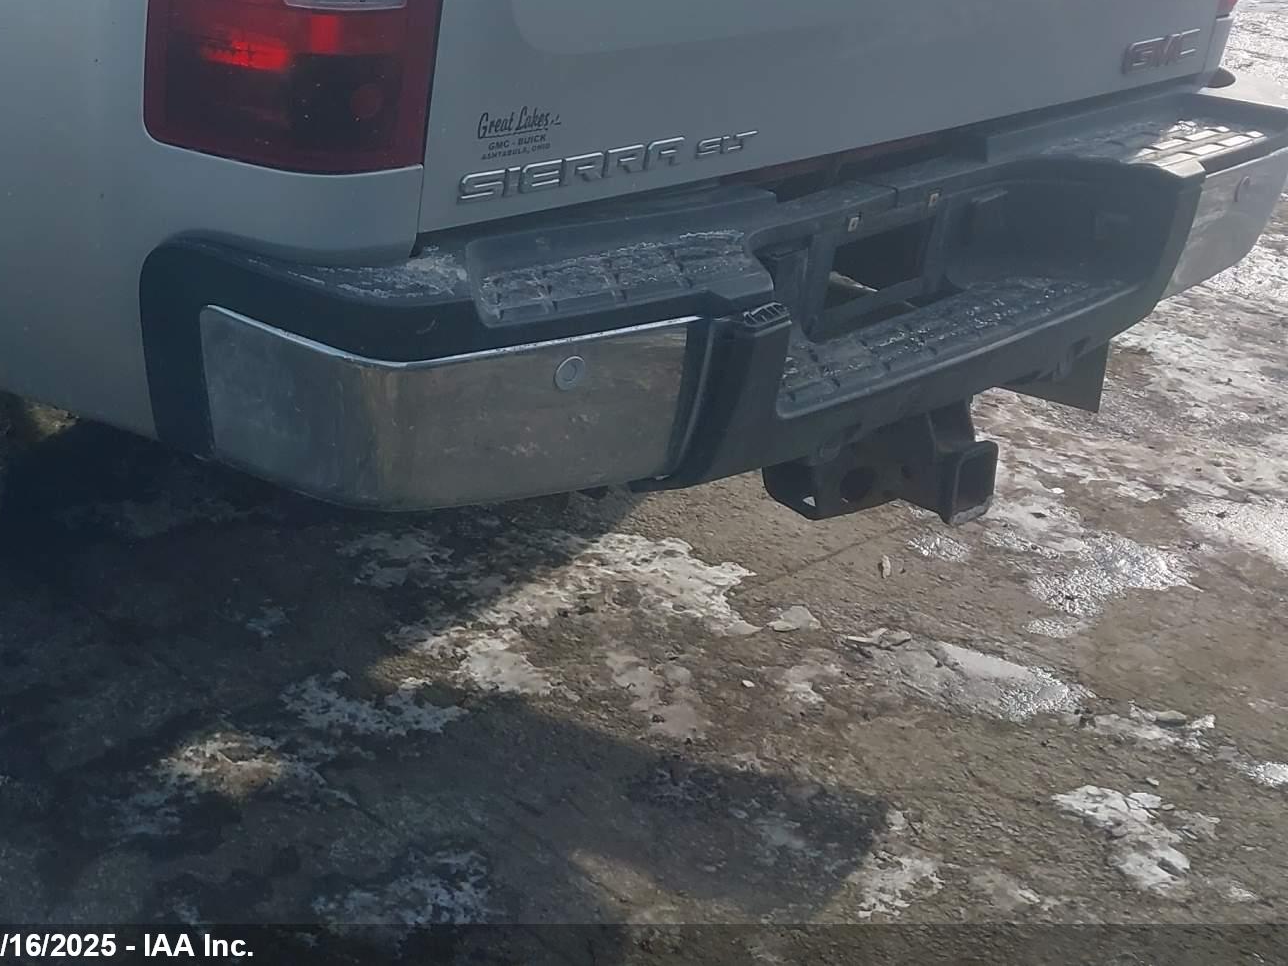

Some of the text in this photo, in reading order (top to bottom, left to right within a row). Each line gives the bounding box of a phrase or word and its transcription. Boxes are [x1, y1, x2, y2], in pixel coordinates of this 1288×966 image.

[477, 111, 515, 139] Great
[514, 105, 551, 131] Lakes
[488, 139, 511, 151] GMC
[517, 133, 546, 146] BUICK
[456, 136, 686, 205] SIERRA
